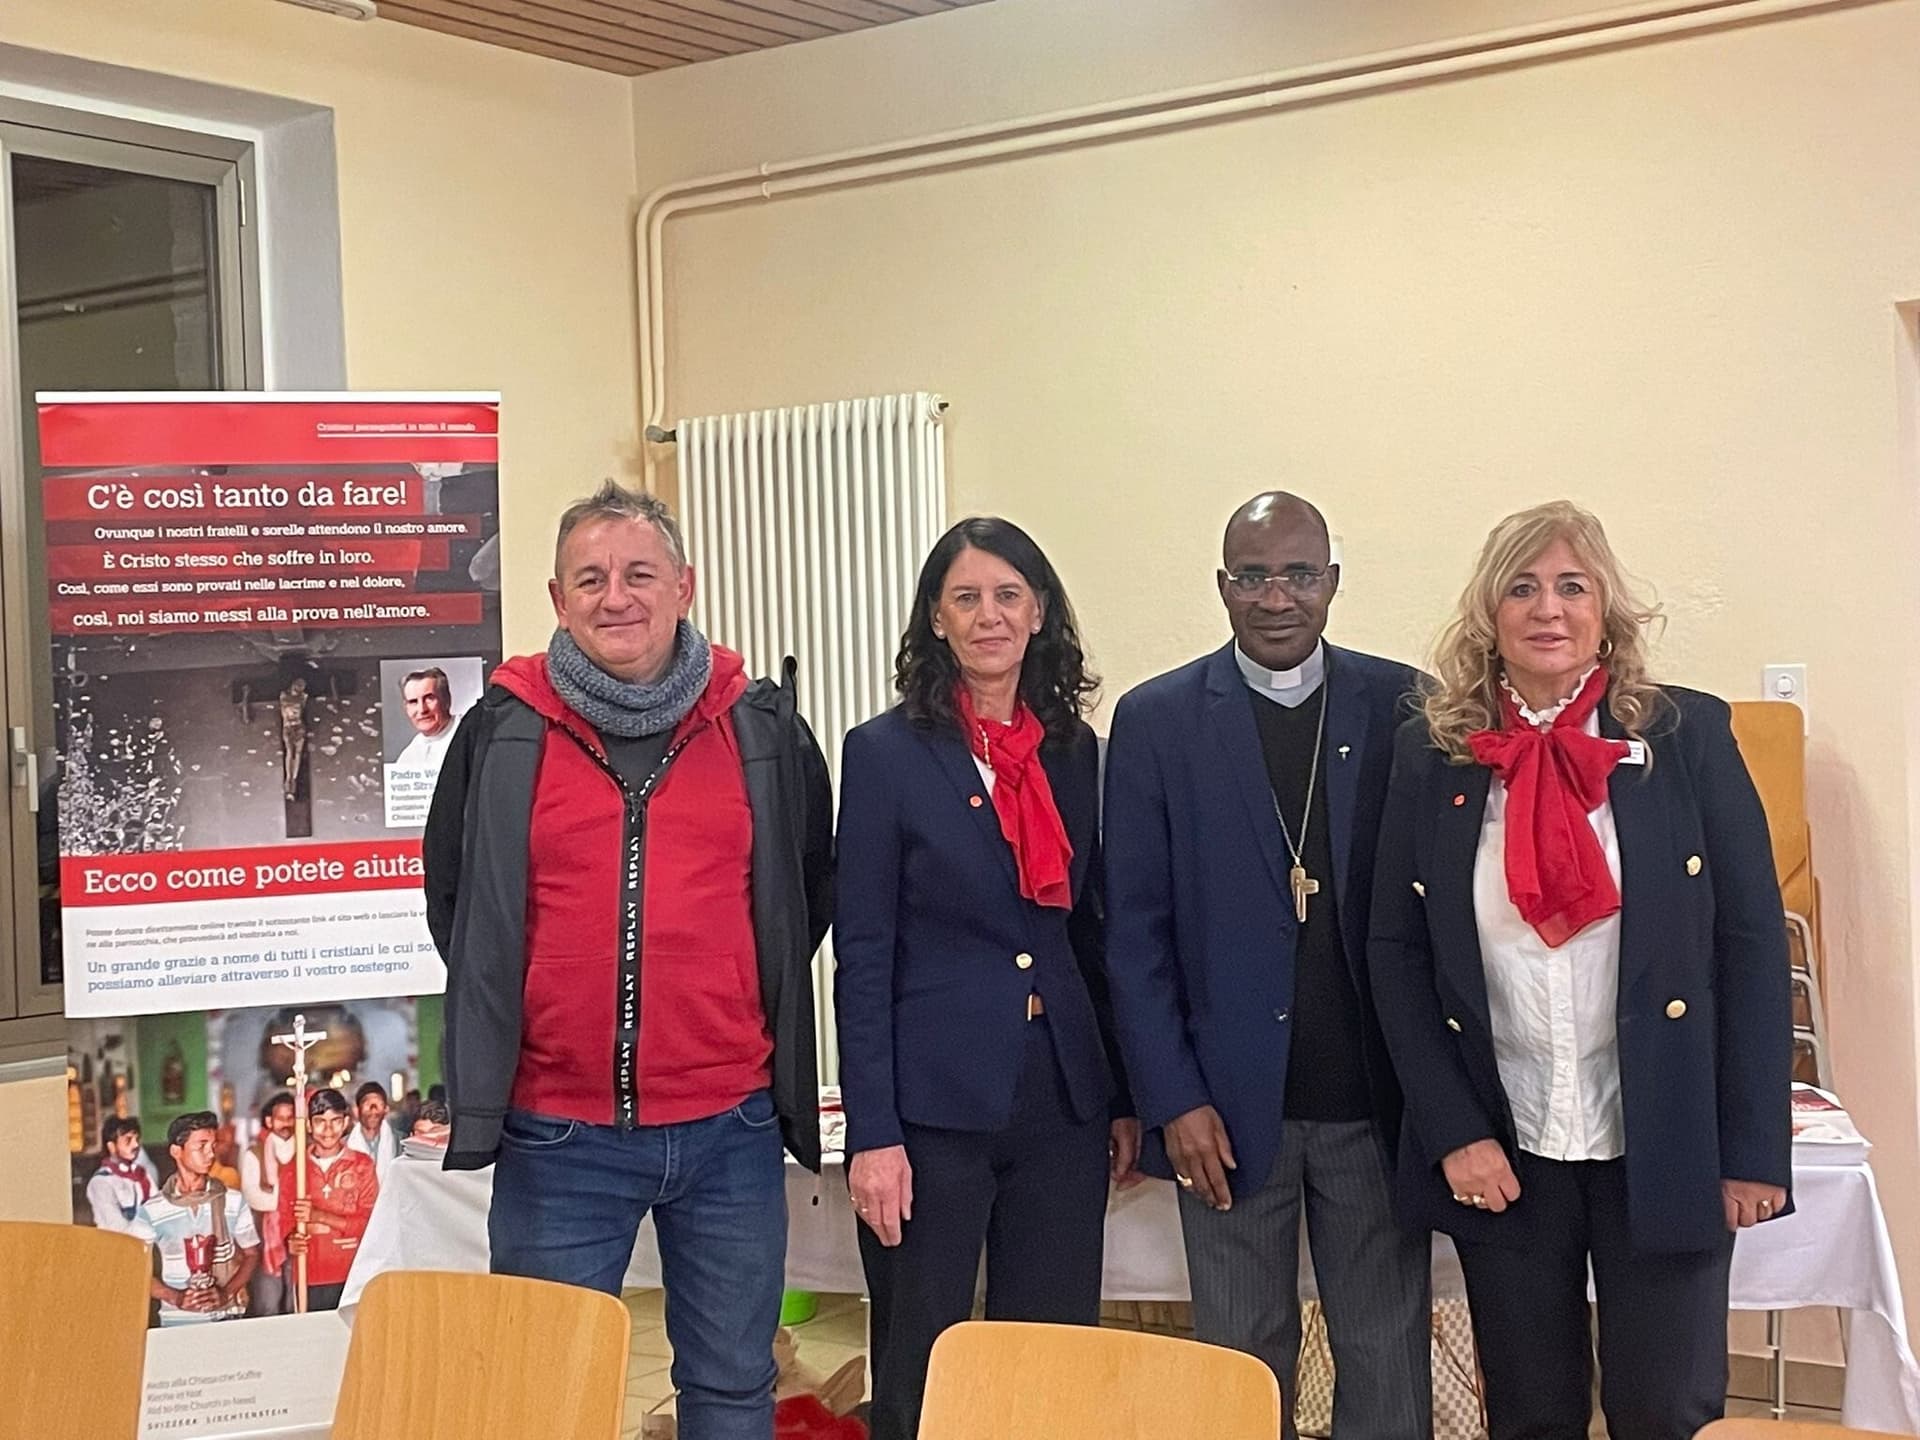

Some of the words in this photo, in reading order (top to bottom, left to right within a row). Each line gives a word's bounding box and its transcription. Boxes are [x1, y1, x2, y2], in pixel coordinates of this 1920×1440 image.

[144, 483, 204, 509] così
[212, 483, 288, 508] tanto
[298, 480, 334, 506] da
[342, 480, 407, 506] fare!
[94, 527, 154, 541] Ovunque
[158, 526, 162, 538] i
[166, 526, 204, 538] nostri
[206, 525, 248, 537] fratelli
[250, 528, 259, 536] e
[262, 524, 304, 536] sorelle
[308, 524, 370, 535] attendono
[374, 522, 381, 534] il
[385, 523, 424, 534] nostro
[427, 524, 468, 534] amore.
[103, 551, 115, 569] È
[120, 553, 170, 568] Cristo
[175, 553, 228, 567] stesso
[233, 550, 263, 566] che
[268, 550, 314, 565] soffre
[320, 550, 336, 564] in
[339, 549, 375, 564] loro.
[94, 584, 129, 594] come
[132, 581, 158, 593] essi
[162, 582, 193, 592] sono
[197, 580, 241, 594] provati
[245, 578, 276, 590] nelle
[279, 578, 326, 589] lacrime
[328, 580, 336, 588] e
[340, 576, 360, 588] nel
[73, 610, 112, 626] così,
[118, 610, 144, 625] noi
[149, 610, 199, 624] siamo
[204, 608, 252, 622] messi
[257, 606, 287, 621] alla
[292, 607, 339, 623] prova
[343, 604, 430, 619] nell'amore.
[391, 770, 422, 780] Padre
[84, 870, 157, 894] Ecco
[166, 866, 246, 890] come
[255, 860, 344, 889] potete
[200, 922, 225, 930] online
[626, 902, 636, 960] REPLAY
[88, 961, 106, 973] Un
[111, 958, 160, 974] grande
[164, 956, 206, 970] grazie
[211, 958, 219, 966] a
[222, 952, 259, 965] nome
[264, 950, 276, 962] di
[280, 948, 307, 961] tutti
[312, 948, 316, 959] i
[320, 944, 374, 958] cristiani
[378, 944, 389, 954] le
[393, 942, 413, 953] cui
[88, 977, 154, 993] possiamo
[158, 972, 216, 987] alleviare
[221, 968, 289, 982] attraverso
[293, 966, 301, 977] il
[305, 964, 346, 976] vostro
[624, 973, 634, 1029] REPLAY
[206, 1408, 288, 1424] LIECHTENSTEIN
